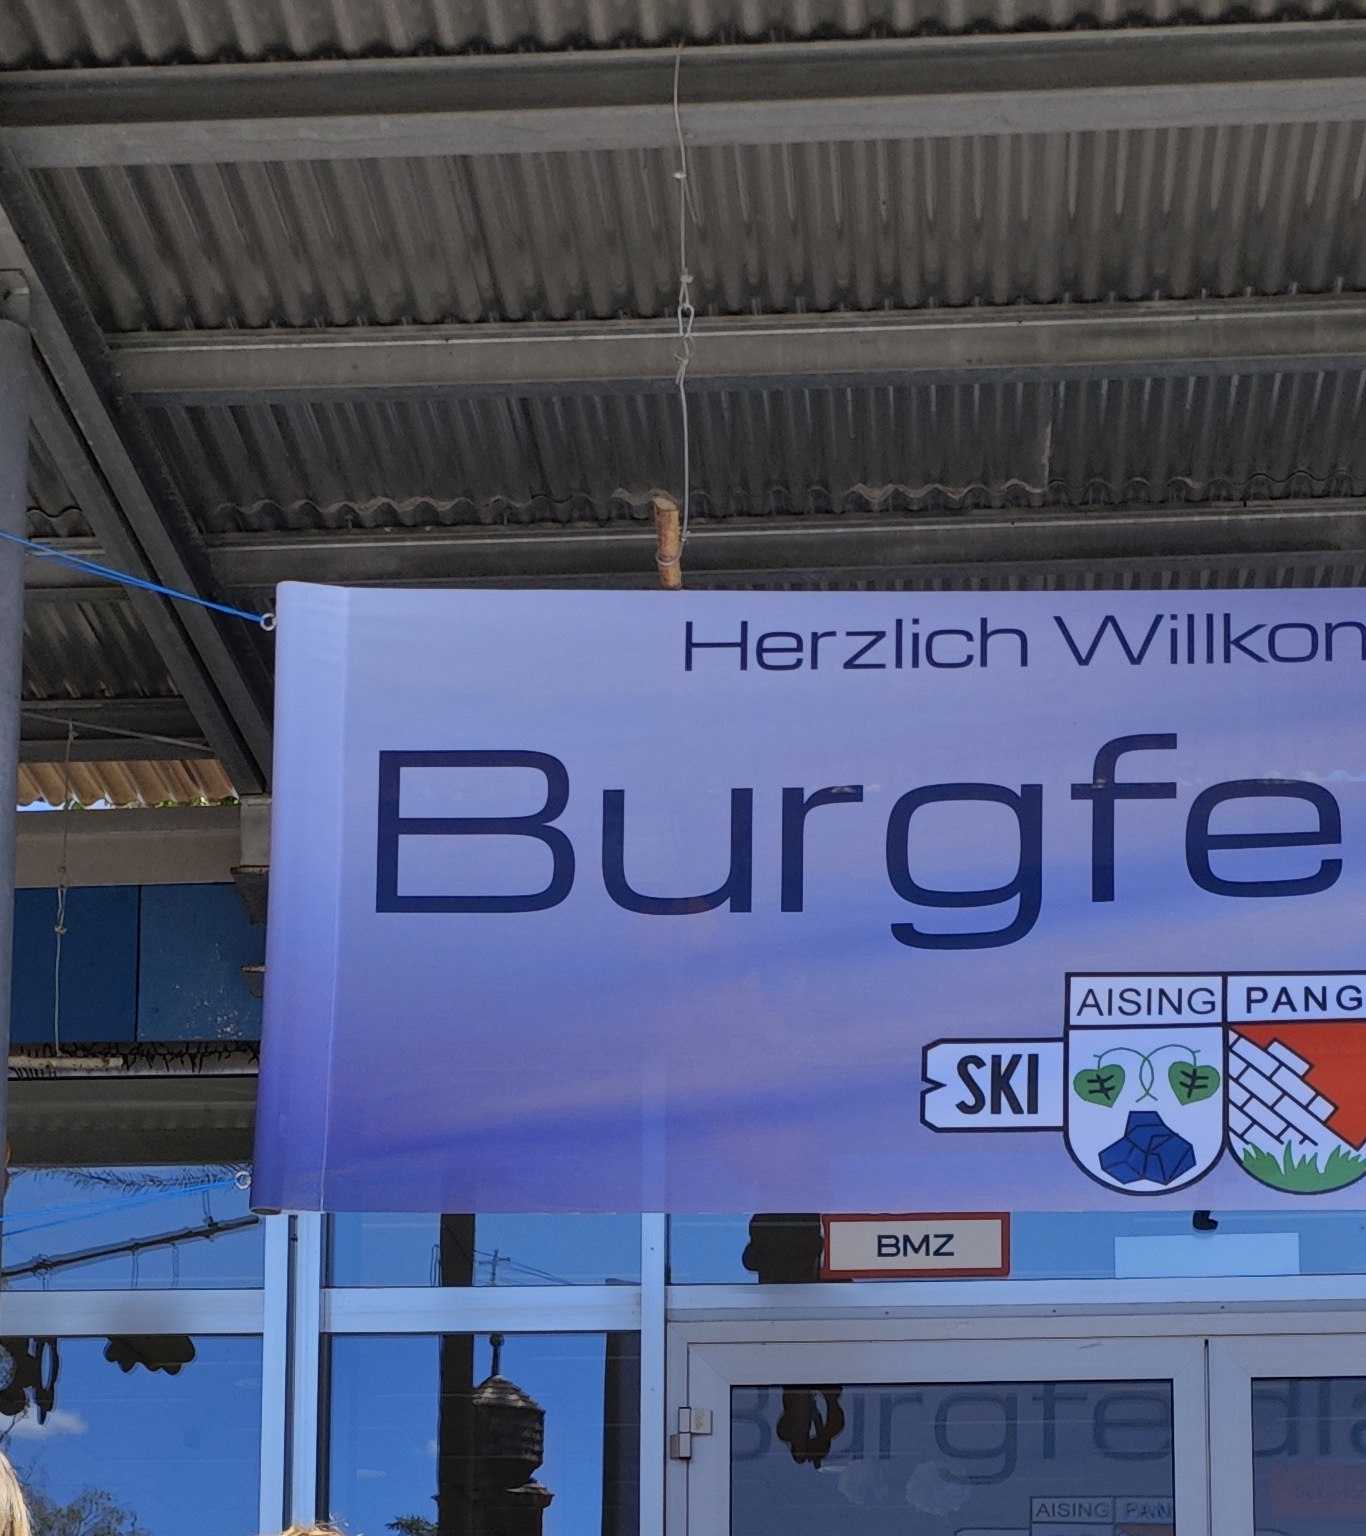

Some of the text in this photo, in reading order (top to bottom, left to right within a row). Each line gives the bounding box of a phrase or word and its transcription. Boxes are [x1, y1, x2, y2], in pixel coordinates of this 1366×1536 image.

[683, 614, 1033, 675] Herzlich
[1076, 983, 1365, 1019] AISING PANG
[955, 1049, 1042, 1115] SKI
[876, 1234, 955, 1256] BMZ
